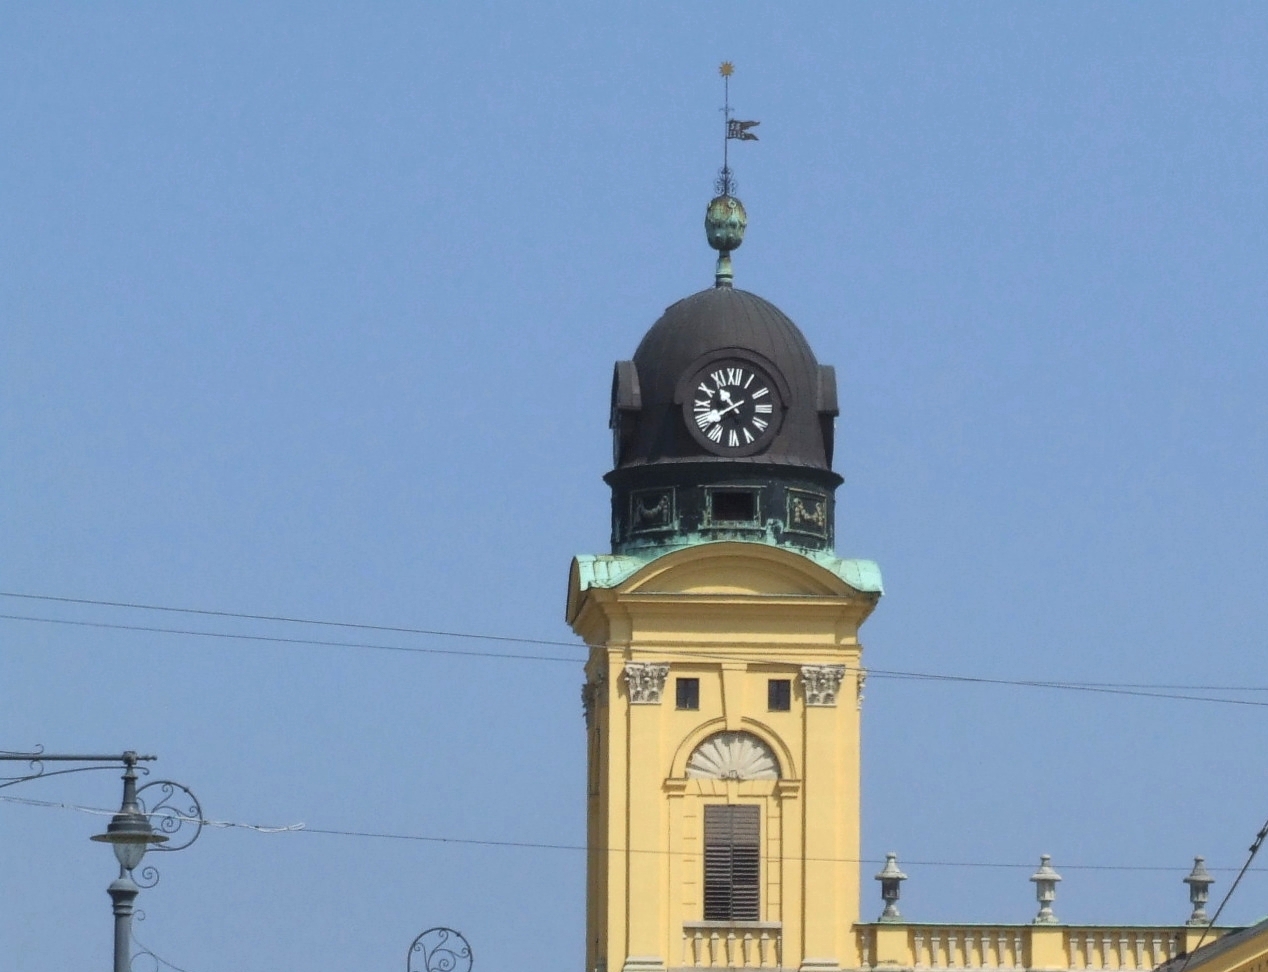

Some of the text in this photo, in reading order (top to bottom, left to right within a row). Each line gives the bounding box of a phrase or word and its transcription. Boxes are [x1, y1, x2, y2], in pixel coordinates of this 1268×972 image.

[711, 370, 726, 389] XI
[727, 368, 742, 386] XII
[698, 382, 715, 398] X
[694, 400, 711, 412] IX
[729, 430, 739, 446] VI
[743, 427, 755, 443] V
